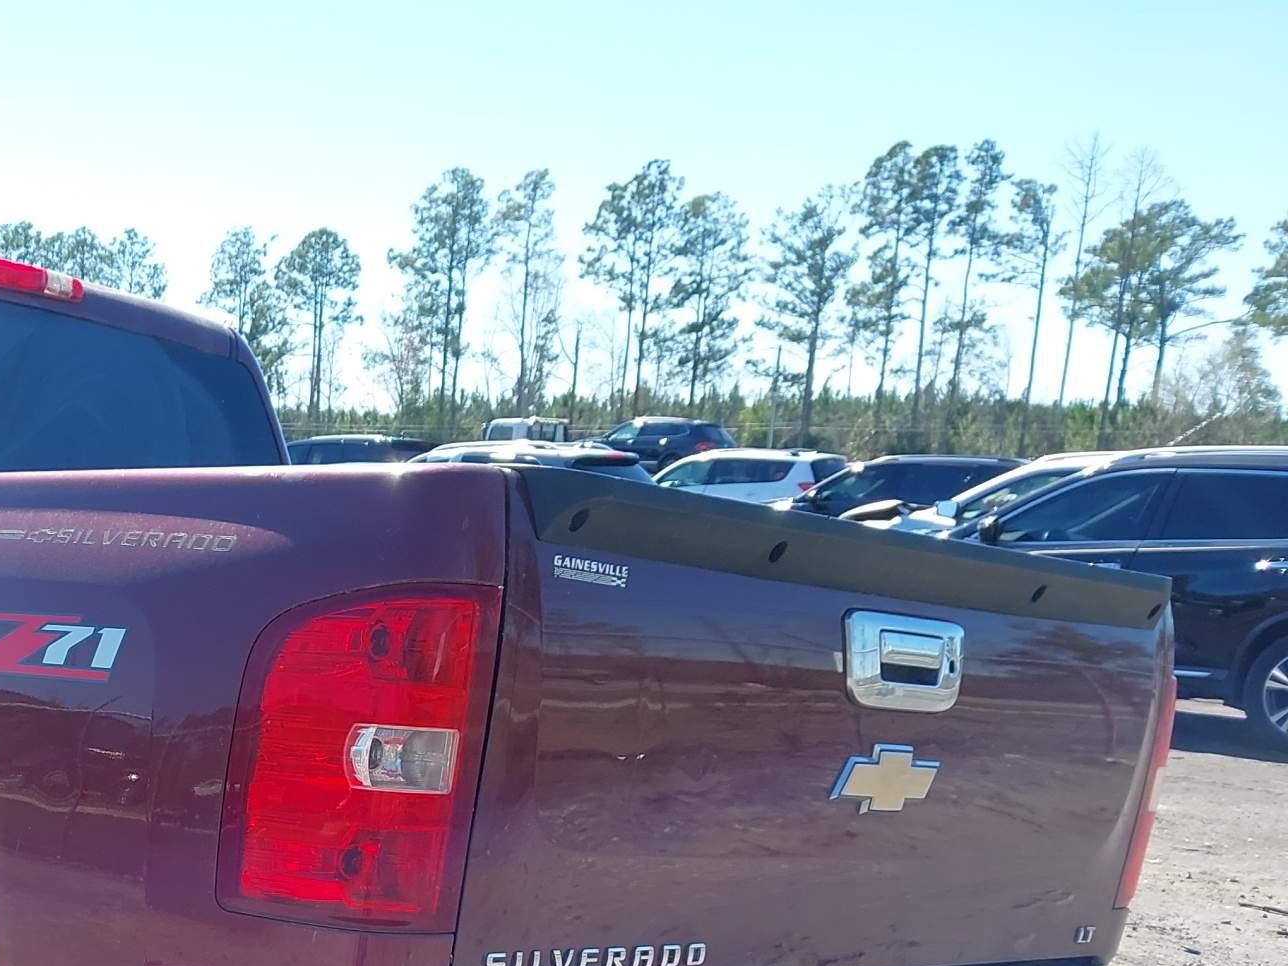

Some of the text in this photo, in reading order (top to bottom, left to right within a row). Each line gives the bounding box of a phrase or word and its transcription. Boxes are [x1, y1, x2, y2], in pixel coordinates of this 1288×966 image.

[54, 528, 238, 552] SILVERADO
[553, 554, 629, 578] GAINESVILLE
[1075, 926, 1097, 943] LT
